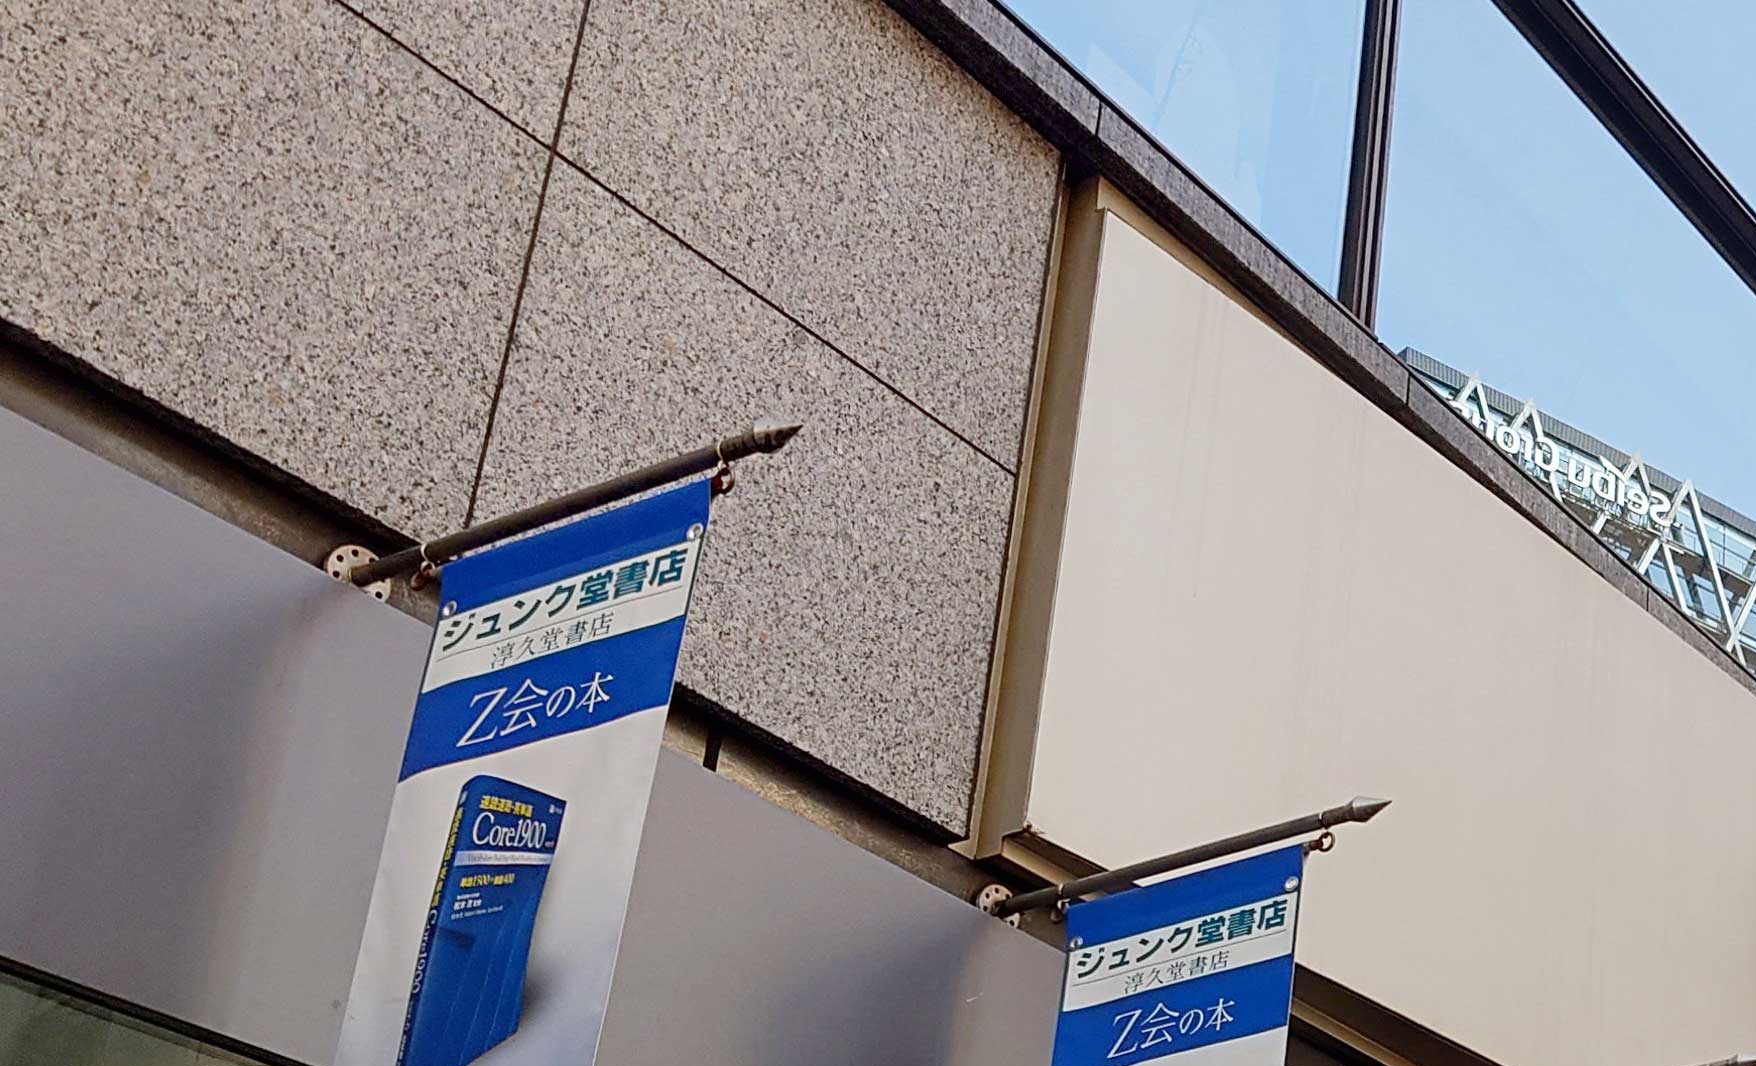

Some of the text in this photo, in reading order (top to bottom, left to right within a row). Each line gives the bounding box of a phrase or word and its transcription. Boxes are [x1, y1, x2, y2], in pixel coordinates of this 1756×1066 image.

[441, 549, 686, 654] ジュンク堂書店
[489, 611, 613, 670] 淳久堂書店
[456, 672, 611, 749] Z会の本
[473, 812, 546, 848] Core1900
[1075, 898, 1288, 979] ジュンク堂書店
[1124, 951, 1230, 994] 淳久堂書店
[1107, 999, 1234, 1059] Z会の本
